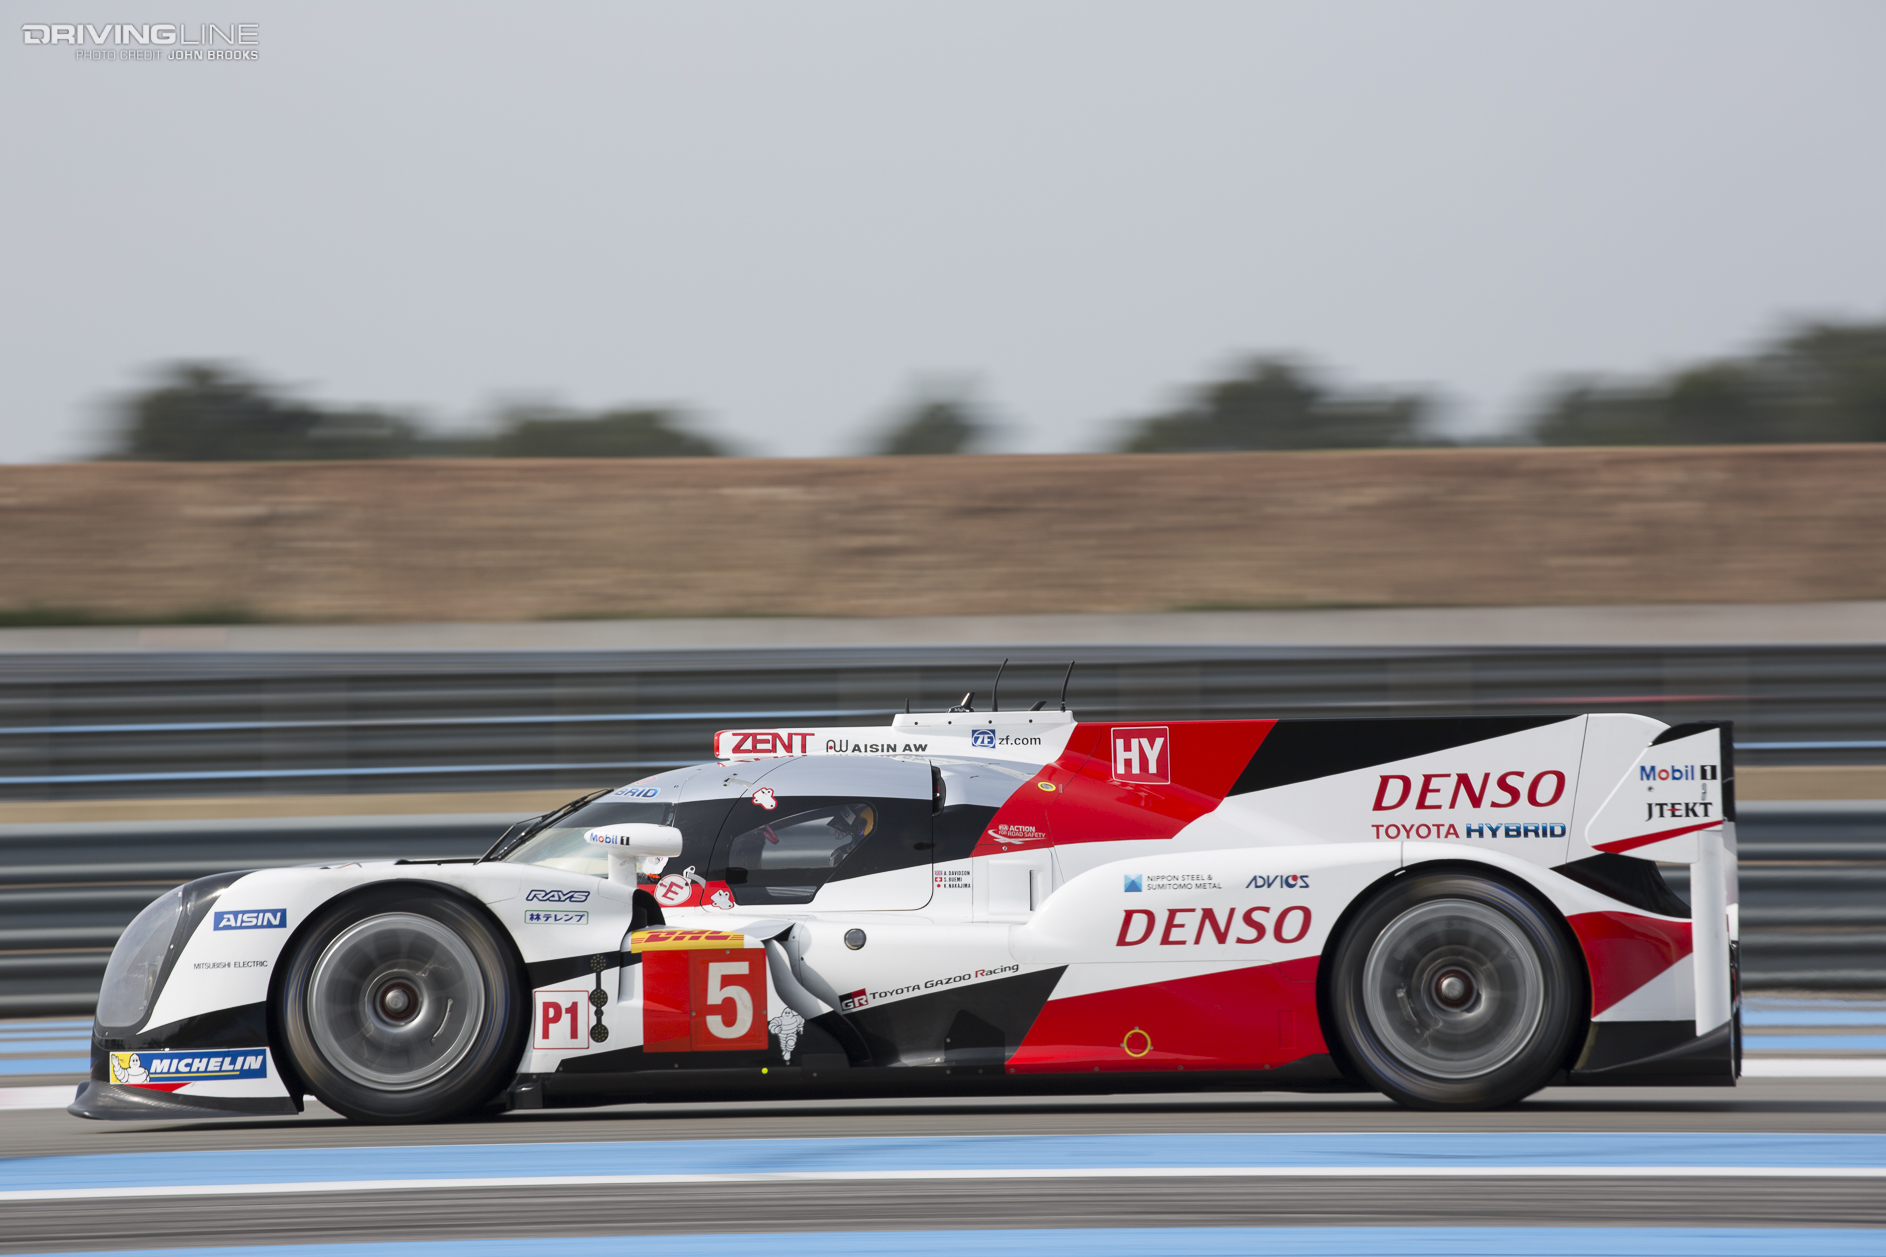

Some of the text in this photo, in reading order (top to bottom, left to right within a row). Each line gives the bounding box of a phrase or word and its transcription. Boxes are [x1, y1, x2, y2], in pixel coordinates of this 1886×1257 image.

[732, 732, 815, 754] ZENT
[851, 743, 897, 753] AISIN
[902, 743, 928, 752] AW
[998, 735, 1042, 746] zf.com
[1115, 737, 1165, 774] HY
[1640, 765, 1695, 781] Mobil
[613, 788, 660, 798] BRID
[1372, 770, 1566, 811] DENSO
[1645, 802, 1713, 822] JTEKT
[590, 832, 618, 844] Mobil
[1371, 822, 1566, 839] TOYOTA HYBRID
[1194, 882, 1223, 890] METAL
[526, 889, 590, 903] RAYS
[218, 912, 282, 928] AISIN
[1115, 905, 1312, 947] DENSO
[643, 930, 731, 943] DHL
[193, 960, 268, 970] MITSUBISHI ELECTRIC
[705, 961, 754, 1040] 5
[841, 995, 869, 1010] GR
[541, 1001, 579, 1040] P1
[150, 1055, 264, 1074] MICHELIN
